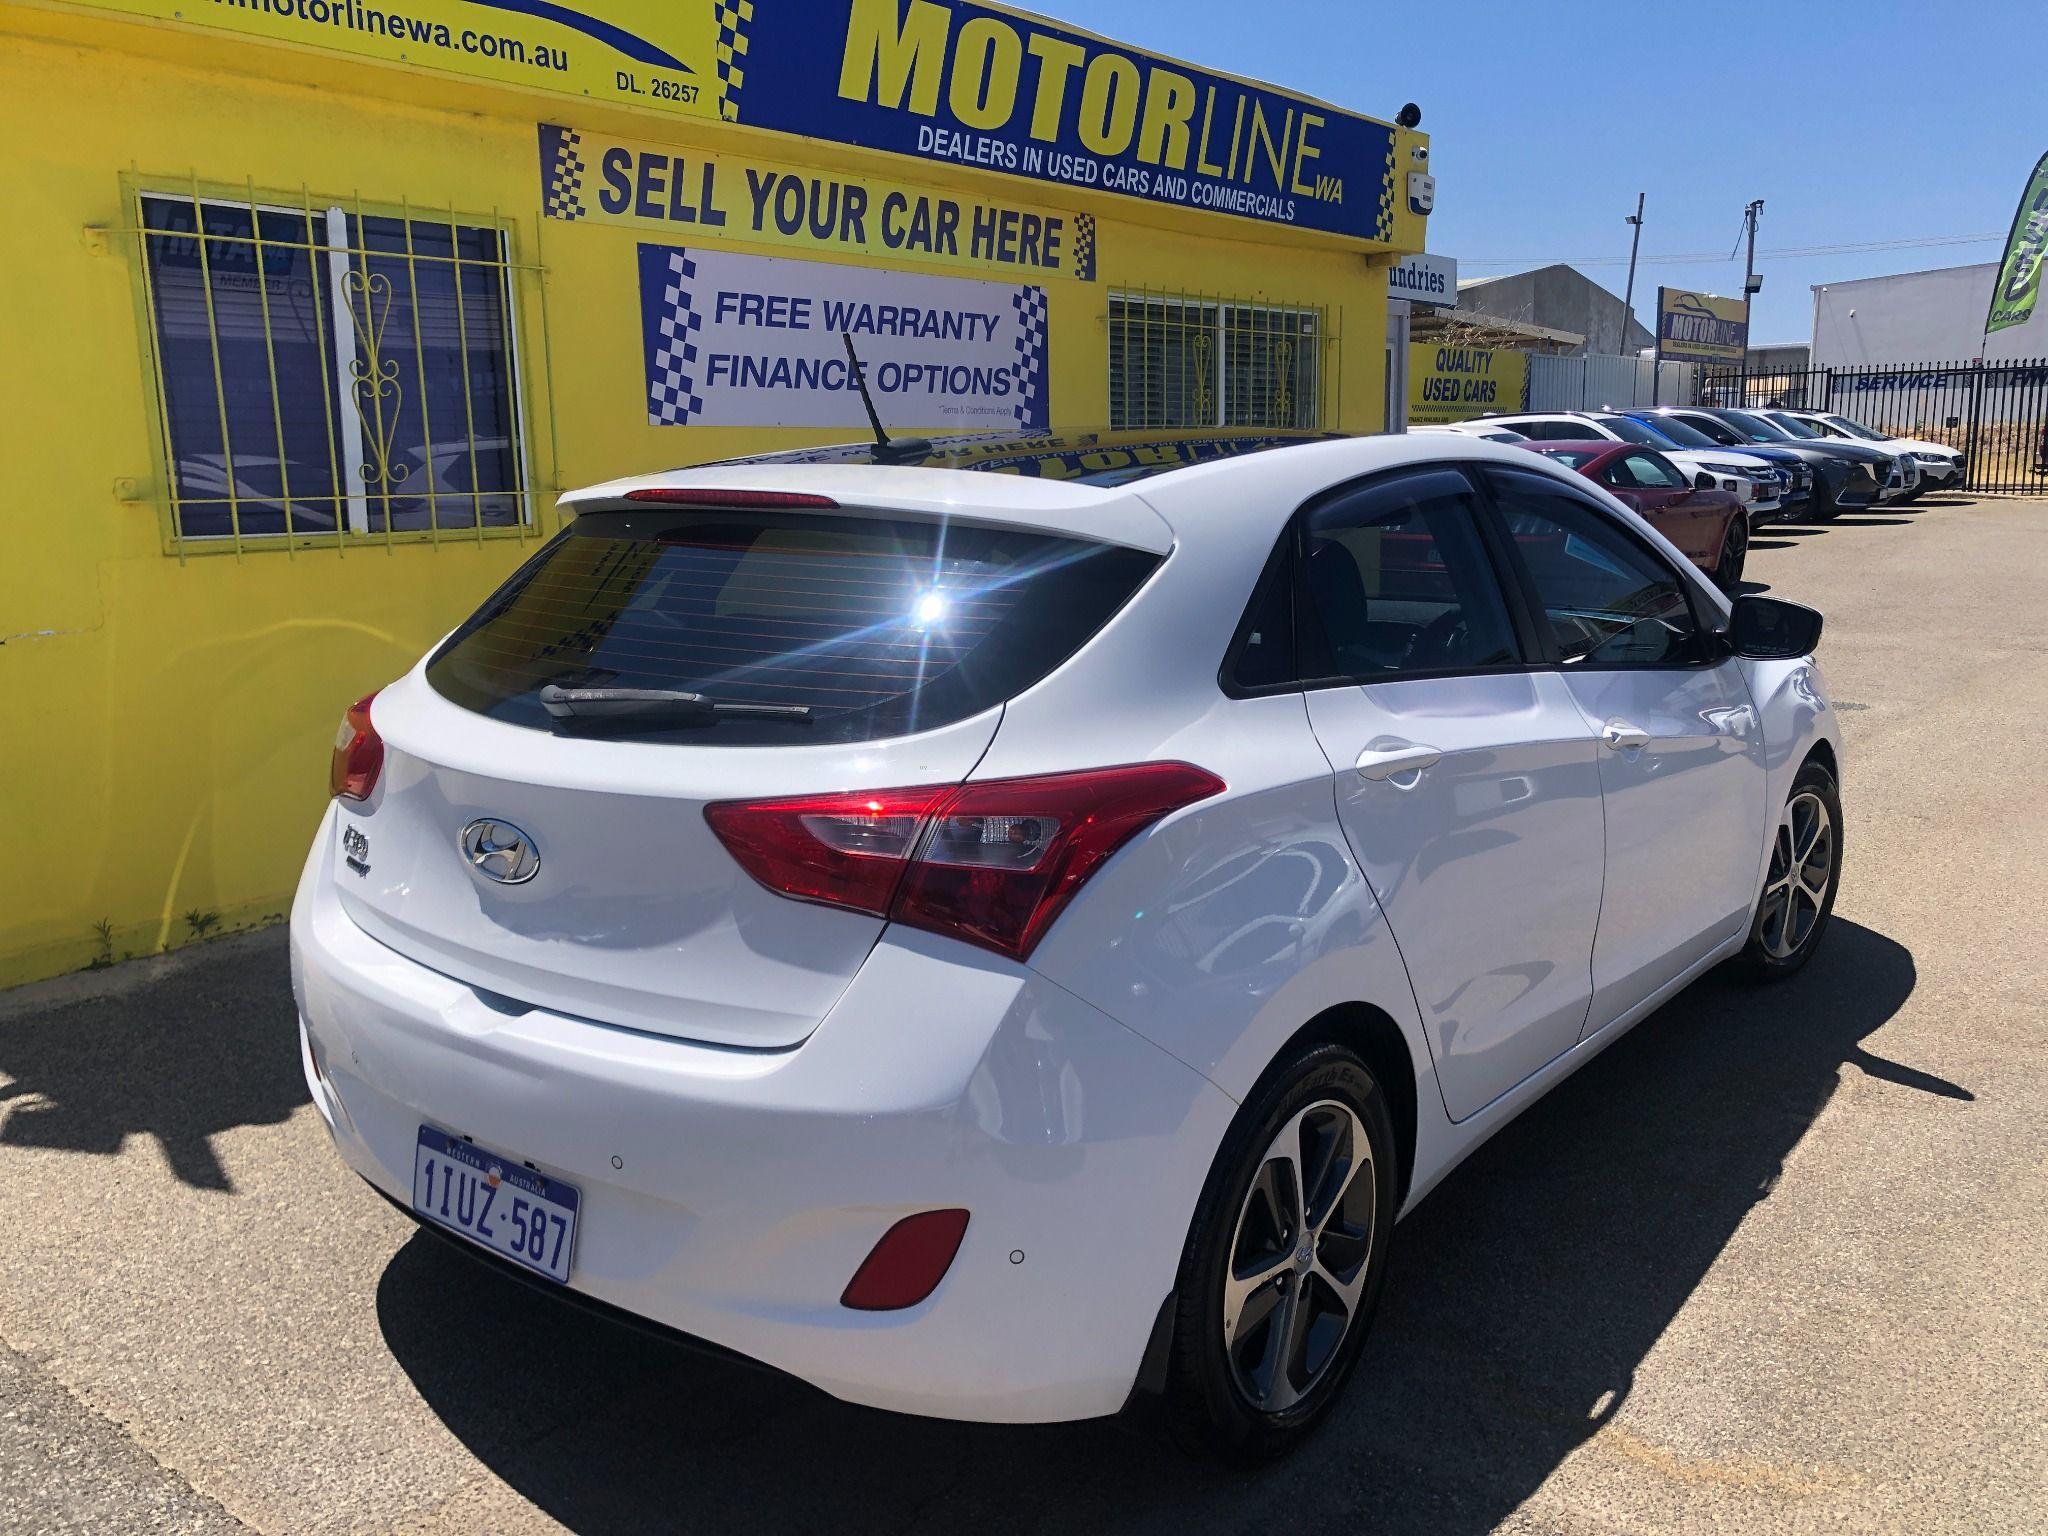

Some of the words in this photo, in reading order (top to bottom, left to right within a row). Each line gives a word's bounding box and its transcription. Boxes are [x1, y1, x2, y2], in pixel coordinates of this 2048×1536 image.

[617, 72, 646, 95] DL.
[651, 79, 699, 104] 26257
[918, 125, 1018, 169] DEALERS
[1023, 146, 1043, 174] IN
[1048, 152, 1098, 183] USED
[1102, 163, 1150, 194] CARS
[1153, 174, 1187, 200] AND
[1191, 181, 1295, 221] COMMERCIALS
[1316, 174, 1343, 204] WA
[599, 147, 726, 226] SELL
[745, 168, 868, 244] YOUR
[882, 191, 960, 256] CAR
[970, 205, 1064, 268] HERE
[1389, 262, 1445, 294] undries
[714, 291, 812, 330] FREE
[823, 300, 1001, 342] WARRANTY
[1671, 313, 1737, 346] MOTORLINE
[1992, 308, 2033, 323] CARS
[706, 353, 868, 392] FINANCE
[877, 362, 1012, 396] OPTIONS
[1436, 348, 1494, 374] QUALITY
[1423, 377, 1461, 402] USED
[1464, 378, 1497, 403] CARS
[1855, 373, 1949, 391] SERVICE
[446, 1147, 480, 1168] WESTERN
[510, 1174, 546, 1198] AUSTRALIA
